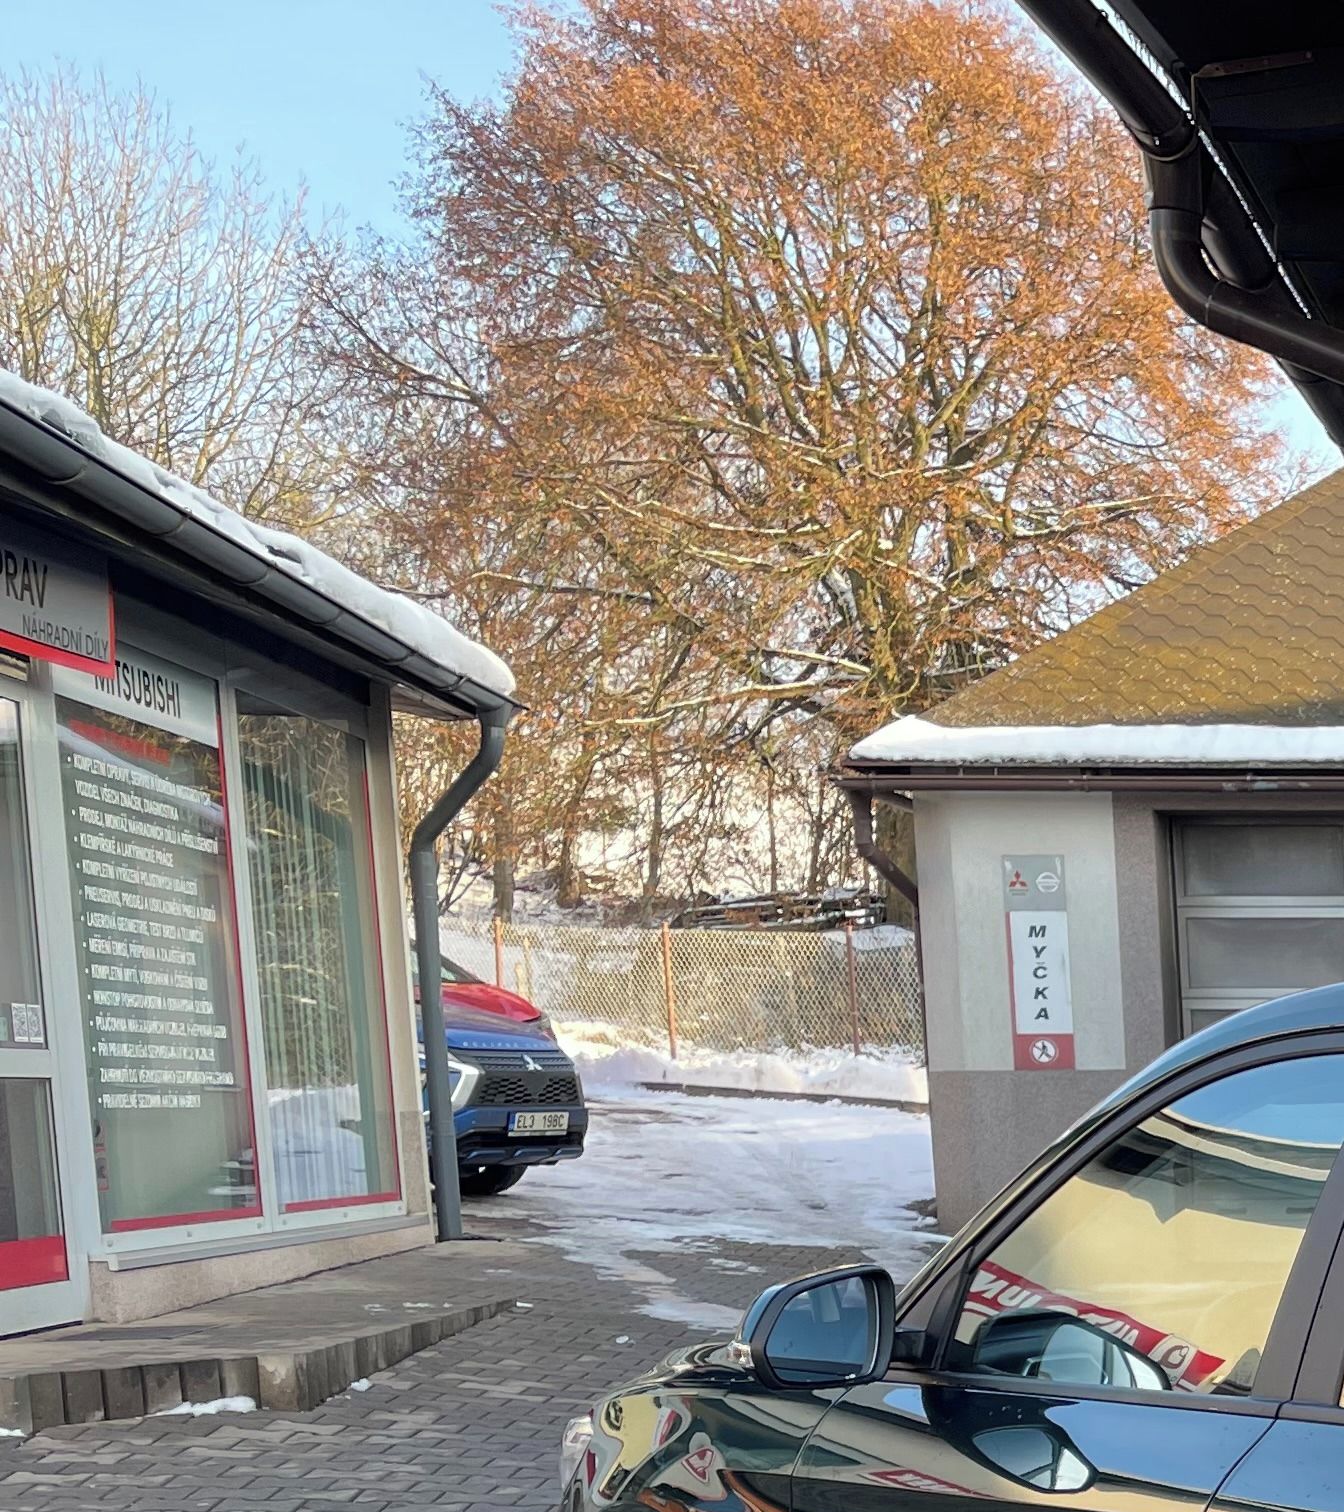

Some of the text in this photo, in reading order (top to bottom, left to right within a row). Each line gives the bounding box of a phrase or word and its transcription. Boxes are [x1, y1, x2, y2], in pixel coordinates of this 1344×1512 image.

[0, 549, 48, 609] RAV
[22, 611, 109, 661] NÁHRADNÍ DÍLY
[1027, 925, 1050, 1020] MYČKA
